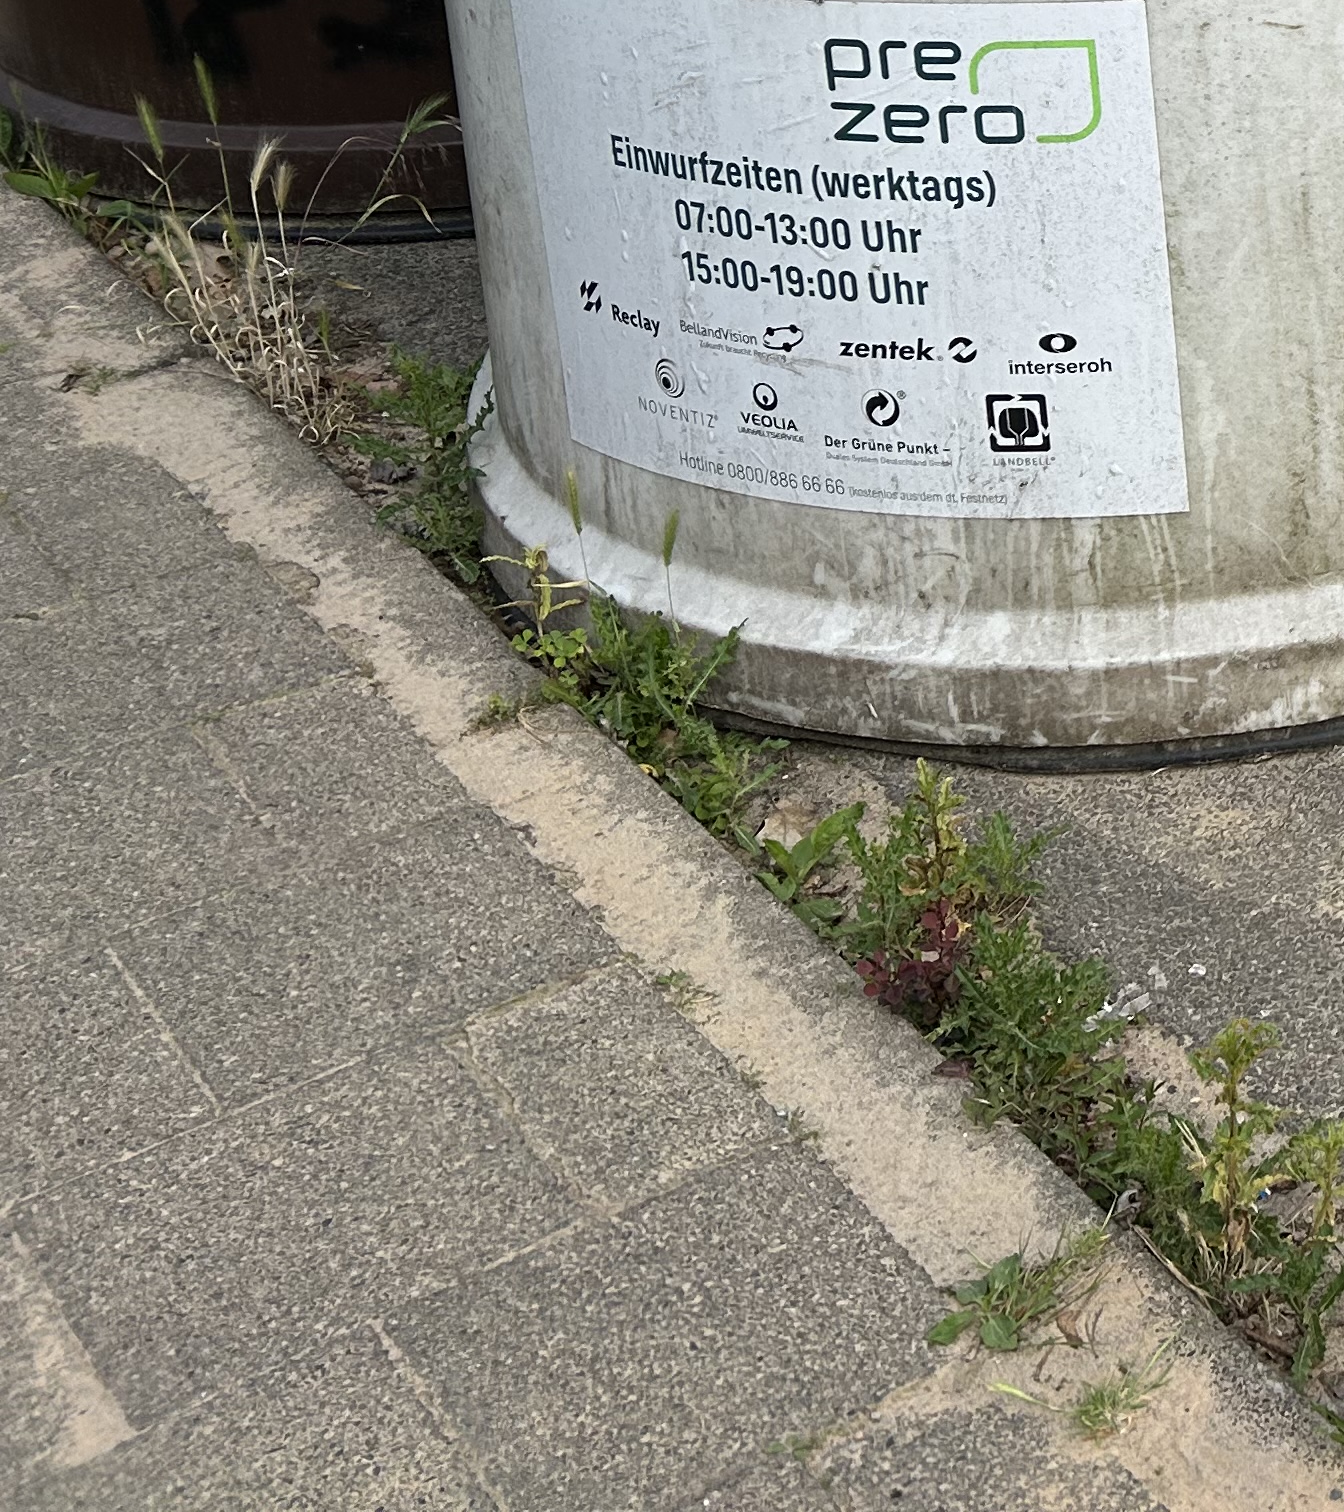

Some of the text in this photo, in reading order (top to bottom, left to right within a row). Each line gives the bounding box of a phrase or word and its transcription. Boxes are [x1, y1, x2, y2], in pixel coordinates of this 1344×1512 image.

[824, 38, 962, 91] pre
[830, 101, 1026, 145] zero
[610, 134, 997, 209] Einwurfzeiten (werktags)
[674, 199, 922, 253] 07:00-13:00 Uhr
[681, 251, 929, 306] 15:00-19:00 Uhr
[611, 303, 660, 338] Reclay
[679, 319, 758, 346] BellandVision
[838, 337, 935, 362] zentek
[1008, 358, 1113, 375] interseroh
[740, 411, 799, 432] VEOLIA
[824, 434, 848, 449] Der
[851, 437, 893, 453] Grüne
[897, 441, 939, 455] Punkt
[679, 450, 725, 475] Hotline
[727, 462, 798, 489] 0800/886
[802, 474, 821, 492] 66
[825, 477, 845, 495] 66
